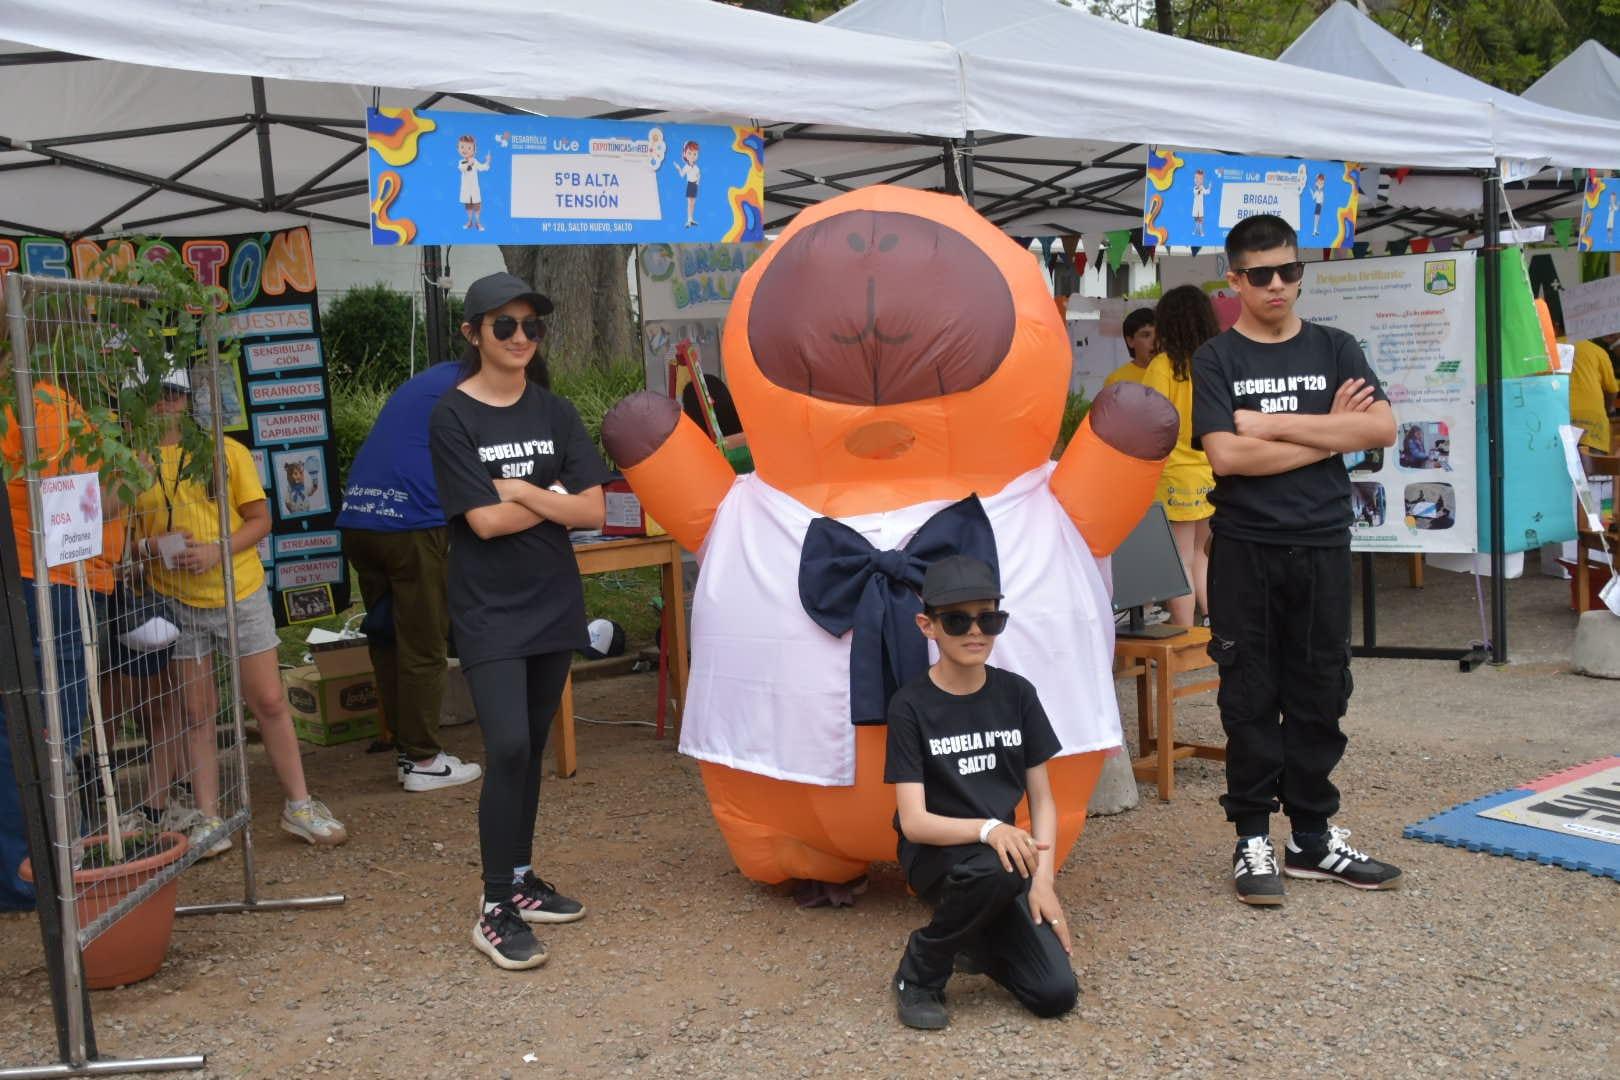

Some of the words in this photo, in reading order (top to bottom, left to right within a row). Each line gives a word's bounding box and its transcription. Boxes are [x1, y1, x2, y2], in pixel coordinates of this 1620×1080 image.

[553, 138, 580, 151] ute
[585, 173, 619, 187] ALTA
[555, 191, 619, 208] TENSIÓN
[1243, 194, 1279, 205] BRIGADA
[568, 223, 588, 232] SALTO
[613, 223, 633, 232] SALTO
[253, 383, 321, 398] BRAINROTS
[1233, 378, 1287, 397] ESCUELA
[1260, 395, 1299, 414] SALTO
[50, 512, 72, 526] ROSA
[282, 535, 332, 549] STREAMING
[280, 560, 338, 575] INFORMATIVO
[958, 752, 997, 775] SALTO
